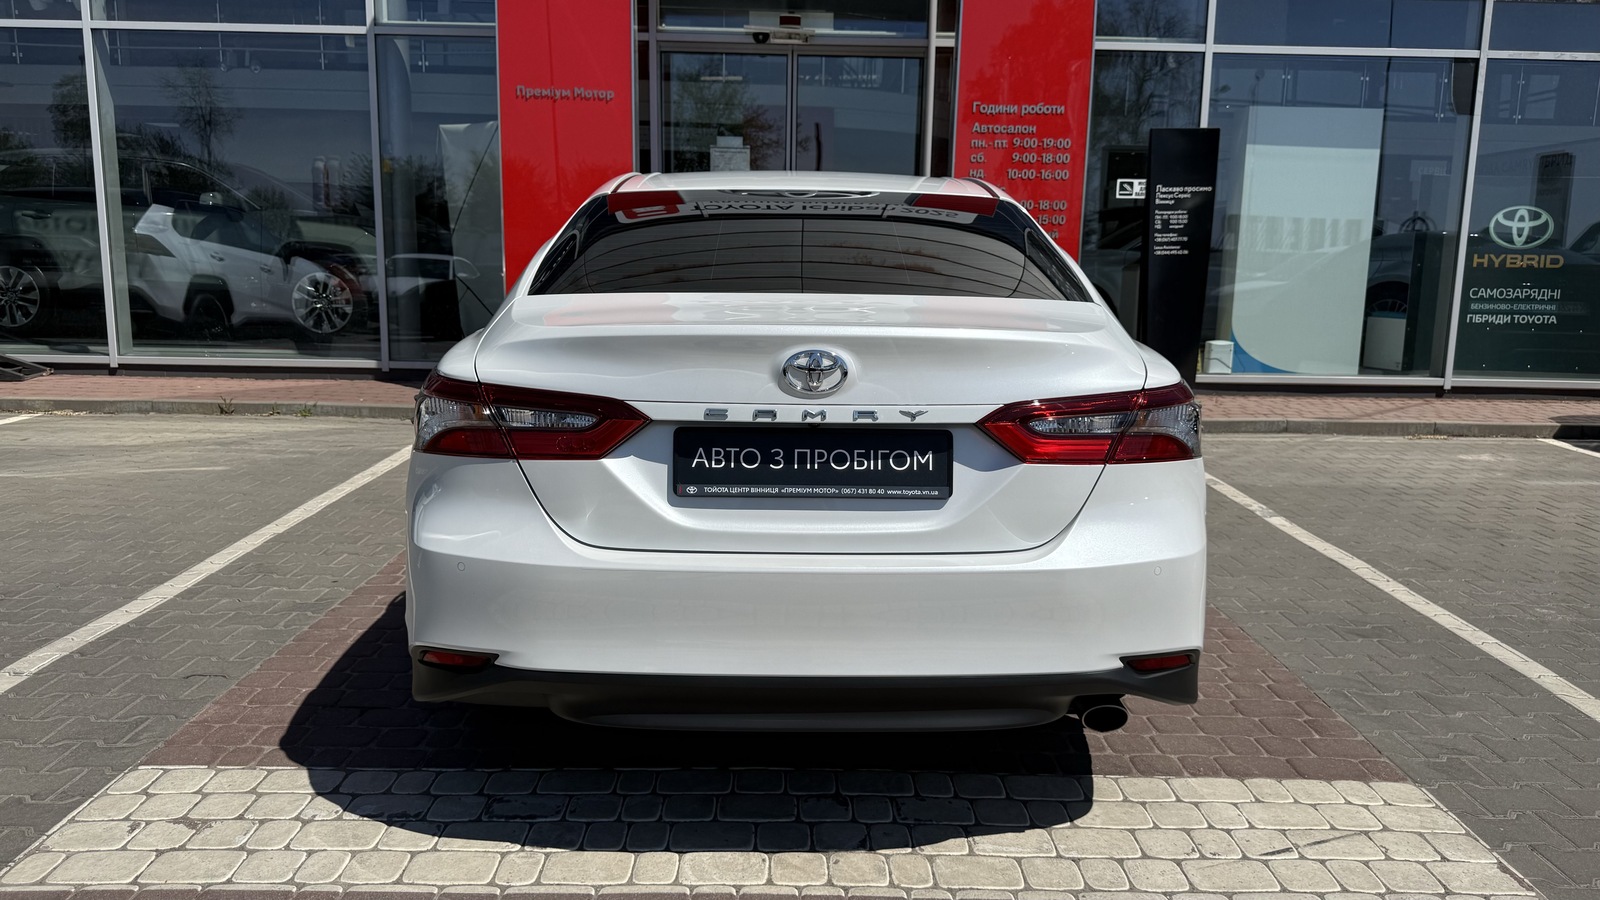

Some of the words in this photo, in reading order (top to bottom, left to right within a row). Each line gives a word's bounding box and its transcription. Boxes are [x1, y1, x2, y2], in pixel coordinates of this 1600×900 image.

[516, 85, 570, 99] Преміум
[573, 87, 615, 101] Мотор
[972, 101, 1018, 115] Години
[1021, 102, 1065, 116] роботи
[972, 122, 1036, 133] Автосалон
[1013, 137, 1071, 149] 9:00-19:00
[970, 152, 986, 163] сб.
[1012, 152, 1070, 164] 9:00-18:00
[1007, 169, 1069, 180] 10:00-16:00
[1472, 253, 1565, 269] HYBRID
[1469, 288, 1561, 301] САМОЗАРЯДНІ
[1470, 303, 1556, 311] БЕНЗИНОВО-ЕЛЕКТРИЧНІ
[1466, 314, 1511, 324] ГІБРИДИ
[1513, 314, 1557, 324] TOYOTA
[703, 408, 929, 422] CAMRY
[691, 448, 762, 469] АВТО
[769, 449, 785, 470] З
[794, 449, 934, 471] ПРОБІГОМ
